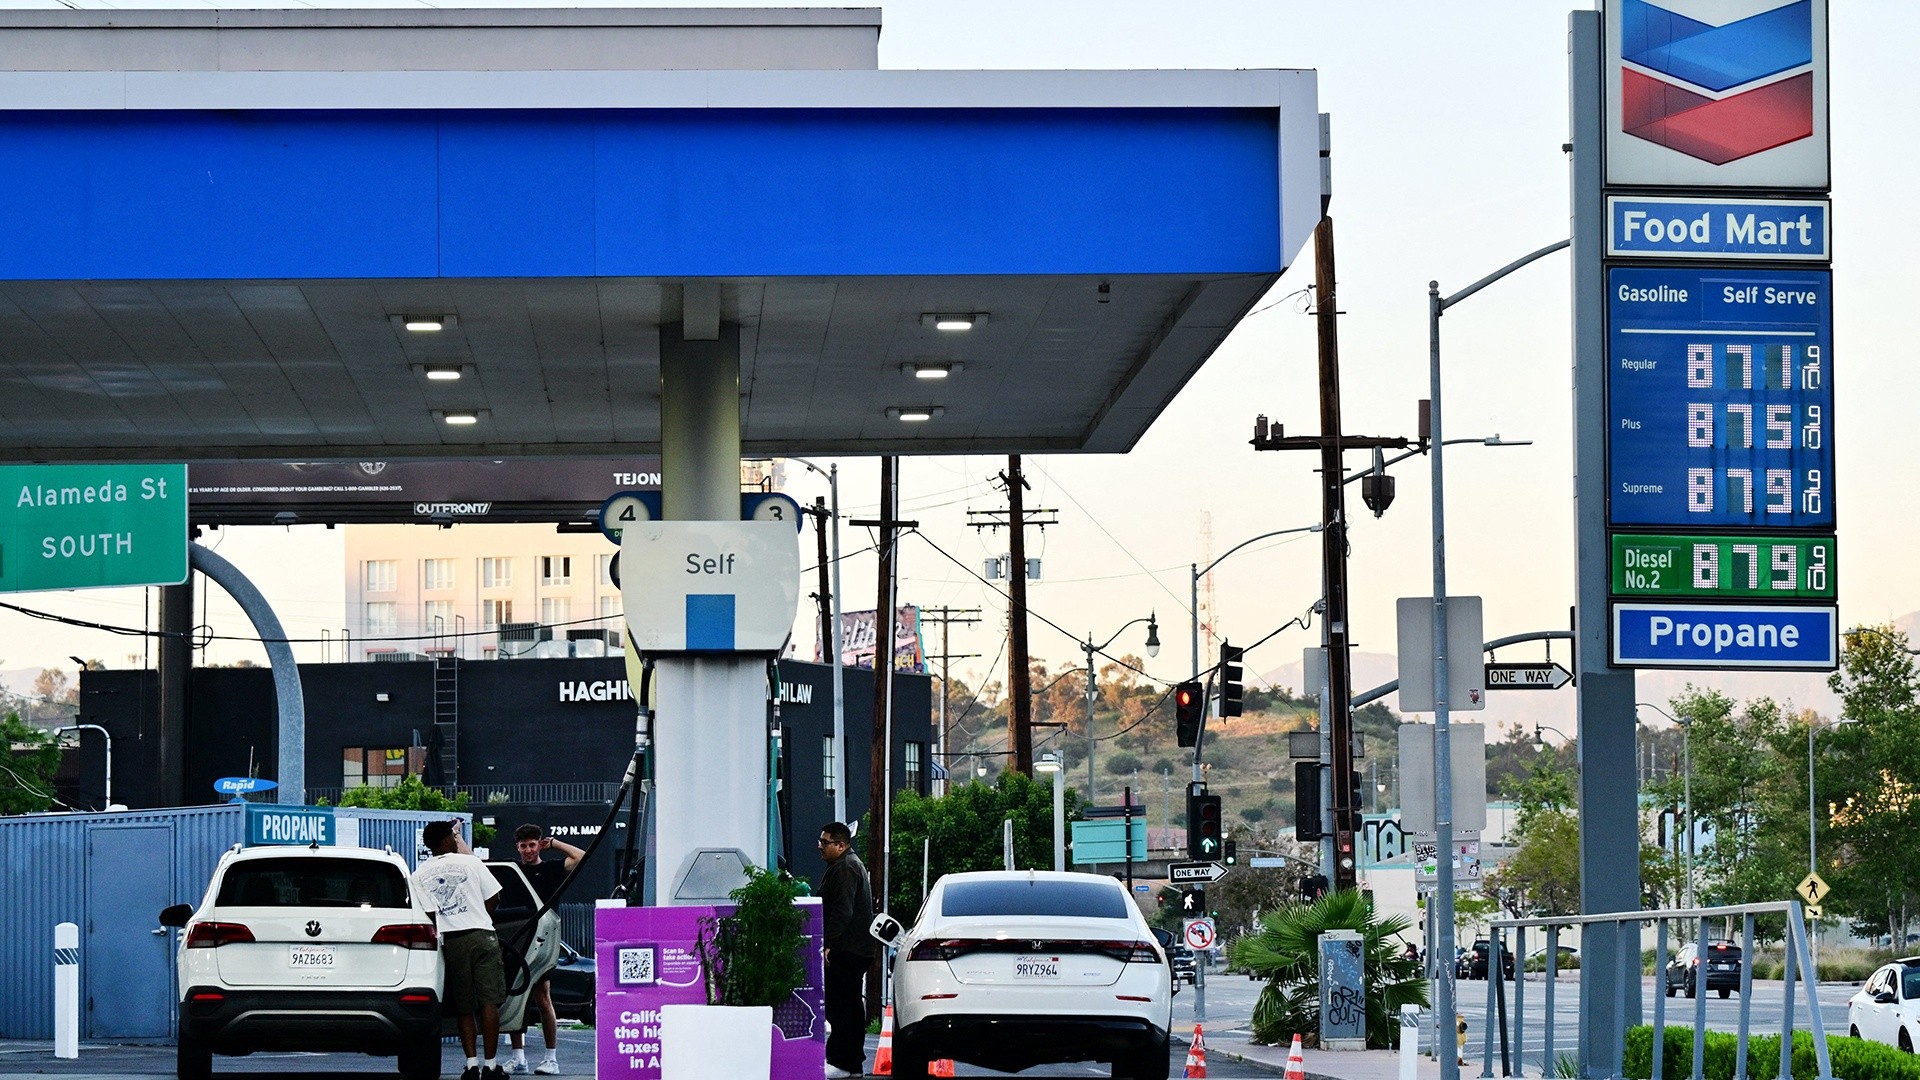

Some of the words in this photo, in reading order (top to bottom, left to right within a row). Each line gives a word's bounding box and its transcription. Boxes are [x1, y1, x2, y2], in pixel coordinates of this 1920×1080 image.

[1623, 211, 1710, 244] Food
[1726, 213, 1813, 246] Mart
[1618, 284, 1688, 303] Gasoline
[1722, 286, 1759, 304] Self
[1764, 286, 1817, 305] Serve
[1621, 358, 1657, 371] Regular
[1687, 344, 1792, 389] 871
[1621, 418, 1641, 430] Plus
[1687, 403, 1792, 449] 875
[613, 472, 661, 486] TEJON
[17, 480, 128, 508] Alameda
[141, 477, 168, 500] St
[1622, 483, 1663, 494] Supreme
[1688, 468, 1793, 514] 879
[618, 504, 636, 521] 4
[768, 505, 783, 521] 3
[42, 532, 133, 559] SOUTH
[686, 553, 735, 575] Self
[1625, 548, 1672, 568] Diesel
[1625, 570, 1660, 588] No.2
[1693, 543, 1798, 590] 879
[1650, 616, 1800, 654] Propane
[1491, 671, 1516, 683] ONE
[1525, 671, 1551, 683] WAY
[790, 683, 812, 704] LAW
[222, 780, 255, 791] Rapid
[262, 814, 326, 841] PROPANE
[550, 825, 568, 836] 739
[570, 825, 580, 836] N.
[1175, 869, 1191, 878] ONE
[1194, 868, 1210, 876] WAY
[292, 953, 333, 965] 9AZB683
[1016, 963, 1058, 976] 9RYZ964
[614, 1025, 640, 1039] the
[618, 1042, 659, 1054] taxes
[630, 1056, 644, 1068] in
